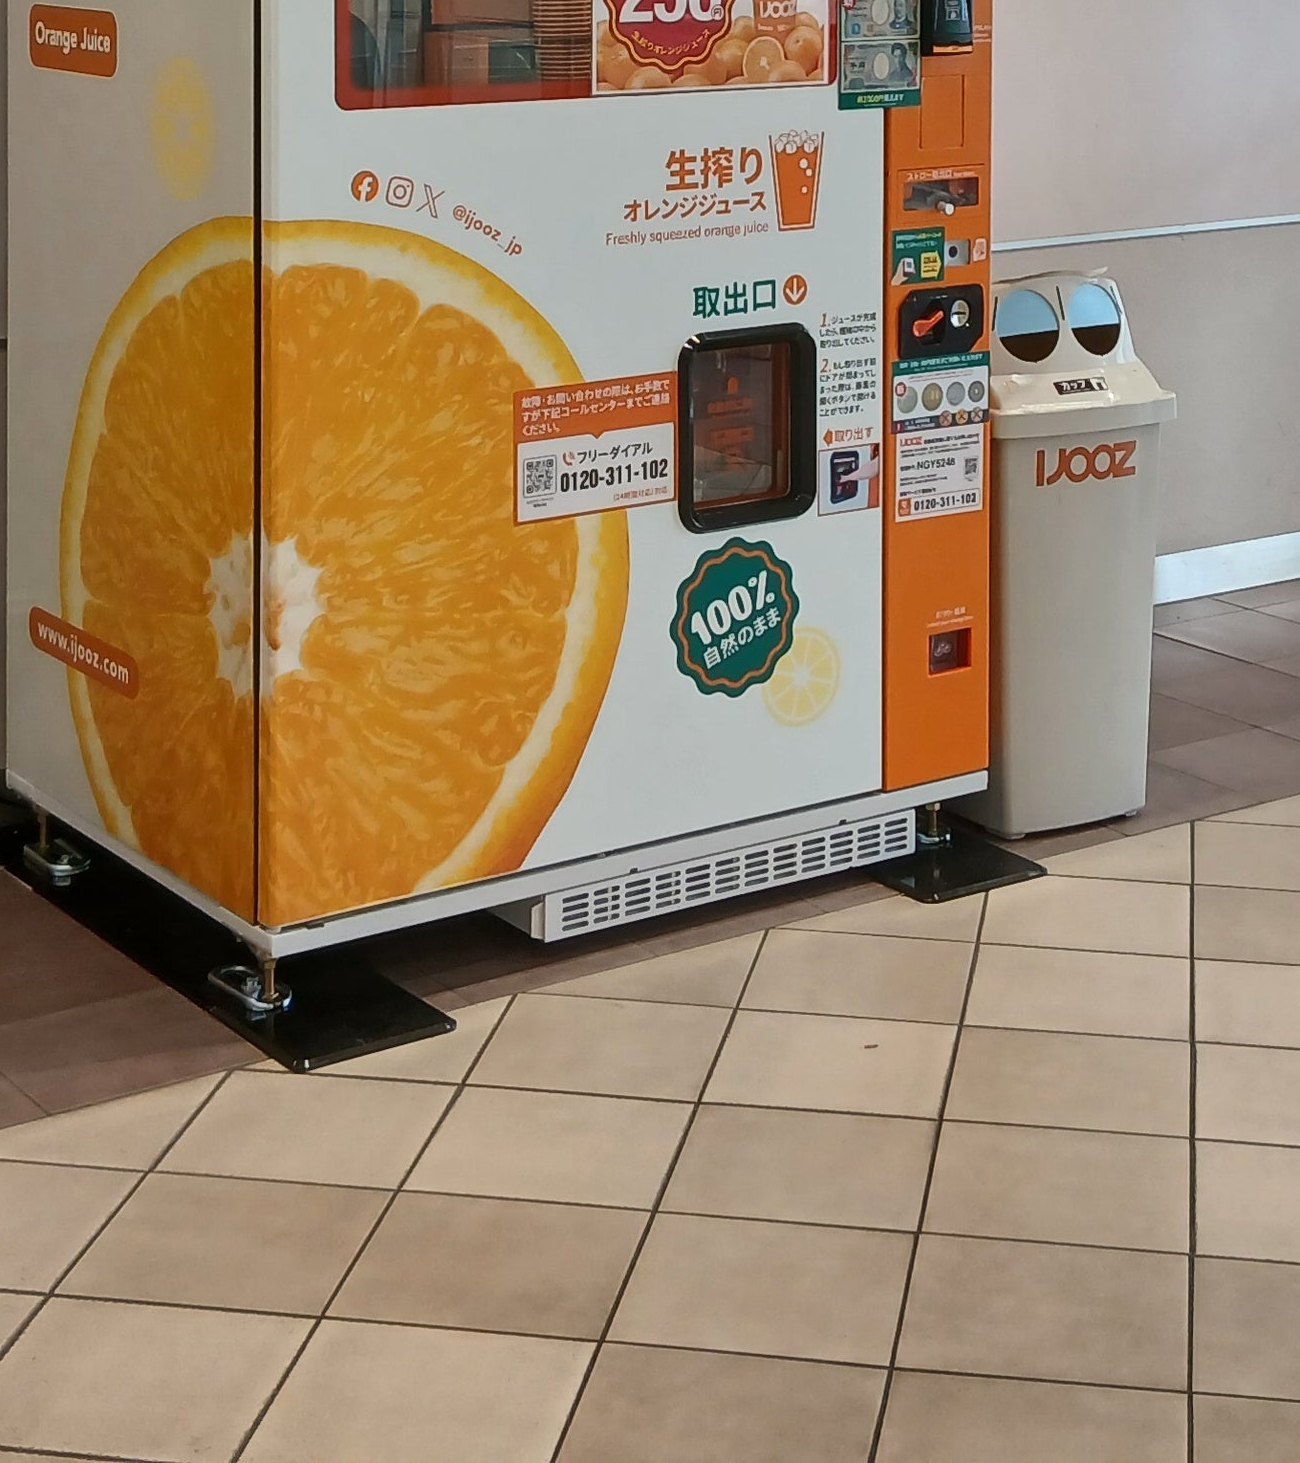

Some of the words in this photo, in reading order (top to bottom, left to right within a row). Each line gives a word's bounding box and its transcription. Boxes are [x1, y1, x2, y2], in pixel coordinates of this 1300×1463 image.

[35, 21, 77, 55] Orange
[80, 25, 111, 53] Juice
[665, 147, 763, 192] 生搾り
[623, 191, 767, 222] オレンジジュース
[452, 204, 523, 257] @ijooz_jp
[605, 230, 647, 247] Freshly
[649, 225, 701, 244] squeezed
[703, 224, 741, 240] orange
[742, 221, 769, 237] juice
[692, 279, 777, 319] 取出口
[577, 442, 653, 464] フリーダイアル
[834, 427, 873, 442] 取り出す
[560, 458, 668, 492] 0120-311-102
[1036, 440, 1137, 487] IJOOZ
[691, 570, 775, 645] 100%
[38, 622, 129, 684] www.ijooz.com
[703, 606, 781, 670] 自然のまま
